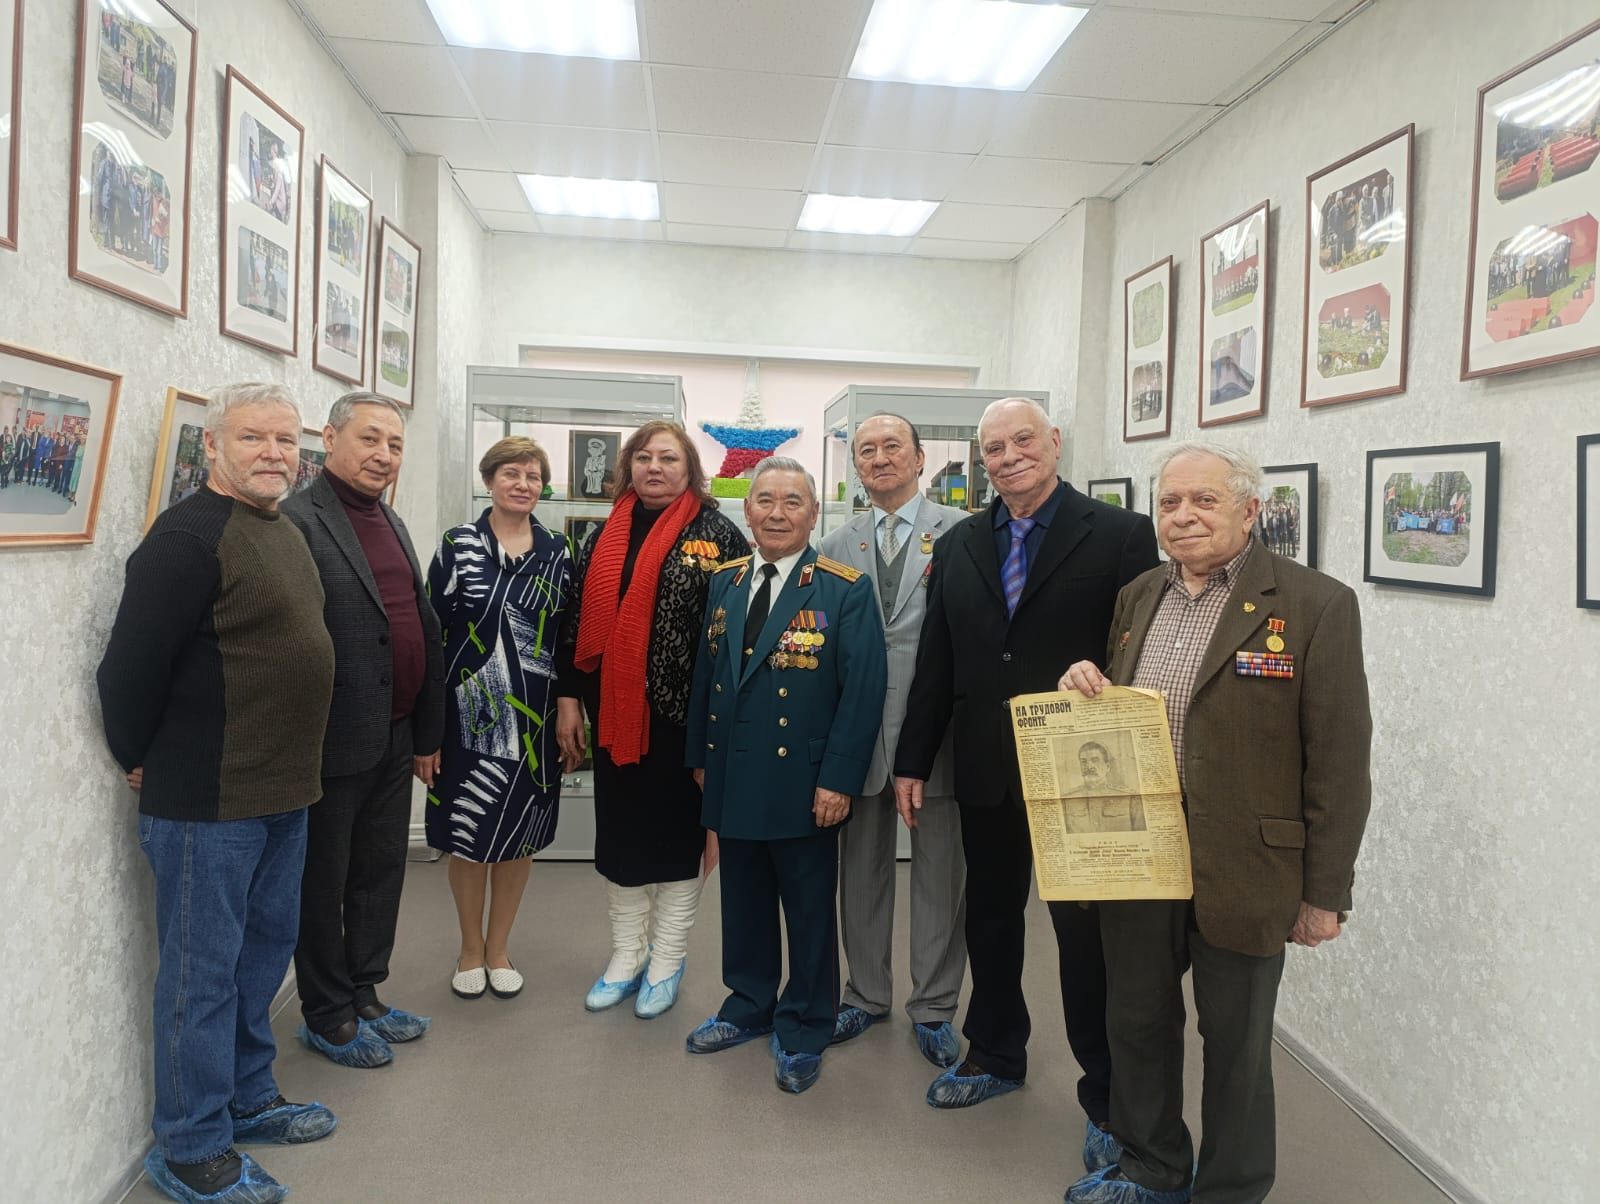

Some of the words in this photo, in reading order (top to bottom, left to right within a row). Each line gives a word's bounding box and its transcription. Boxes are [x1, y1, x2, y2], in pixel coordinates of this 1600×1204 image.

[1015, 705, 1027, 717] НА
[1029, 701, 1072, 715] ТРУДОВОМ
[1017, 716, 1047, 728] ФРОНТЕ
